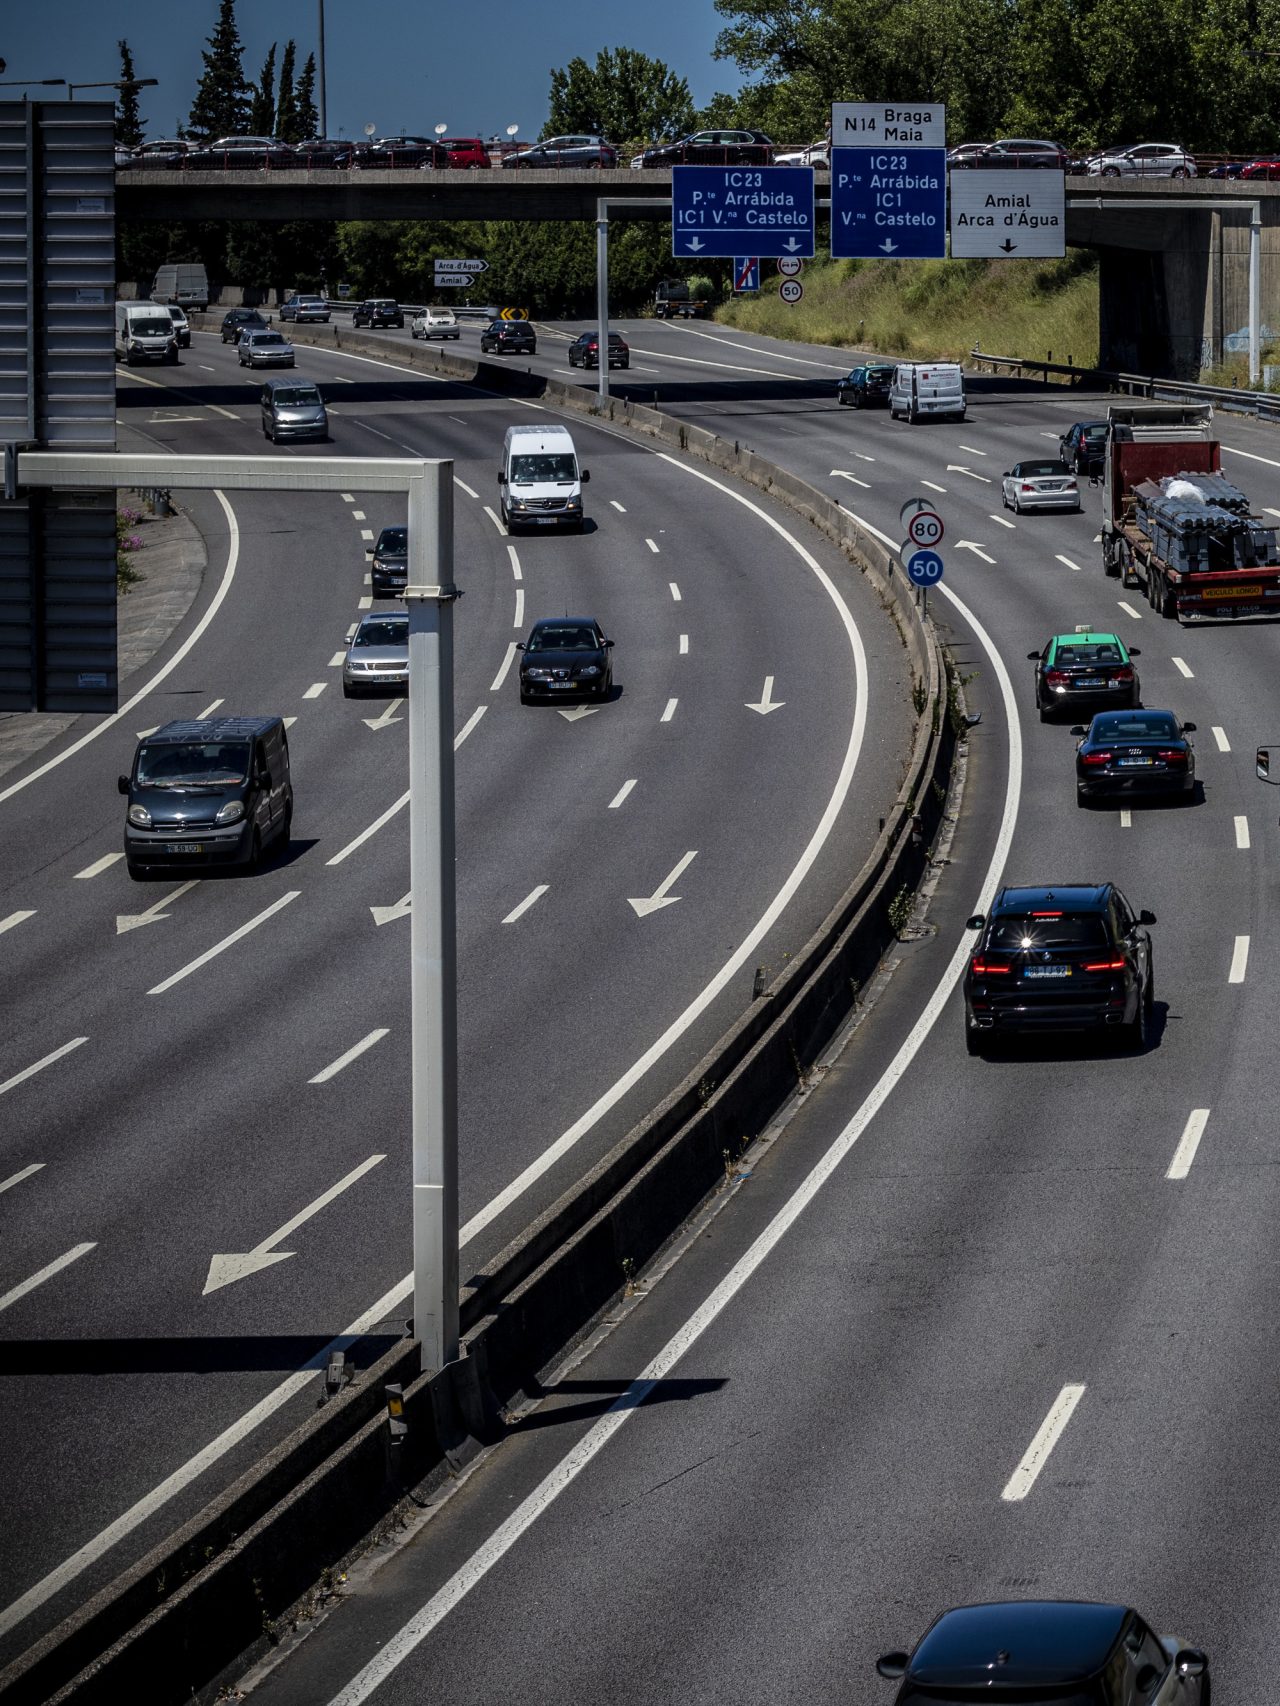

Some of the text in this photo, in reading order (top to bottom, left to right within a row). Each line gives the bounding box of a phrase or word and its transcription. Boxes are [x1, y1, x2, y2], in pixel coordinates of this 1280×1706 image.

[885, 109, 931, 125] Braga
[845, 118, 875, 131] N14
[885, 128, 922, 141] Maia
[871, 156, 906, 169] IC23
[726, 173, 761, 186] IC23
[871, 175, 938, 188] Arrábida
[725, 192, 793, 205] Arrábida
[877, 193, 900, 207] IC1
[985, 194, 1030, 207] Amial
[679, 210, 703, 223] IC1
[746, 210, 807, 224] Castelo
[875, 212, 935, 225] Castelo
[958, 210, 1058, 228] Arca d'Água
[438, 262, 454, 270] Arca
[440, 276, 463, 284] Amial
[785, 287, 798, 296] 50
[914, 522, 939, 538] 80
[913, 561, 939, 577] 50
